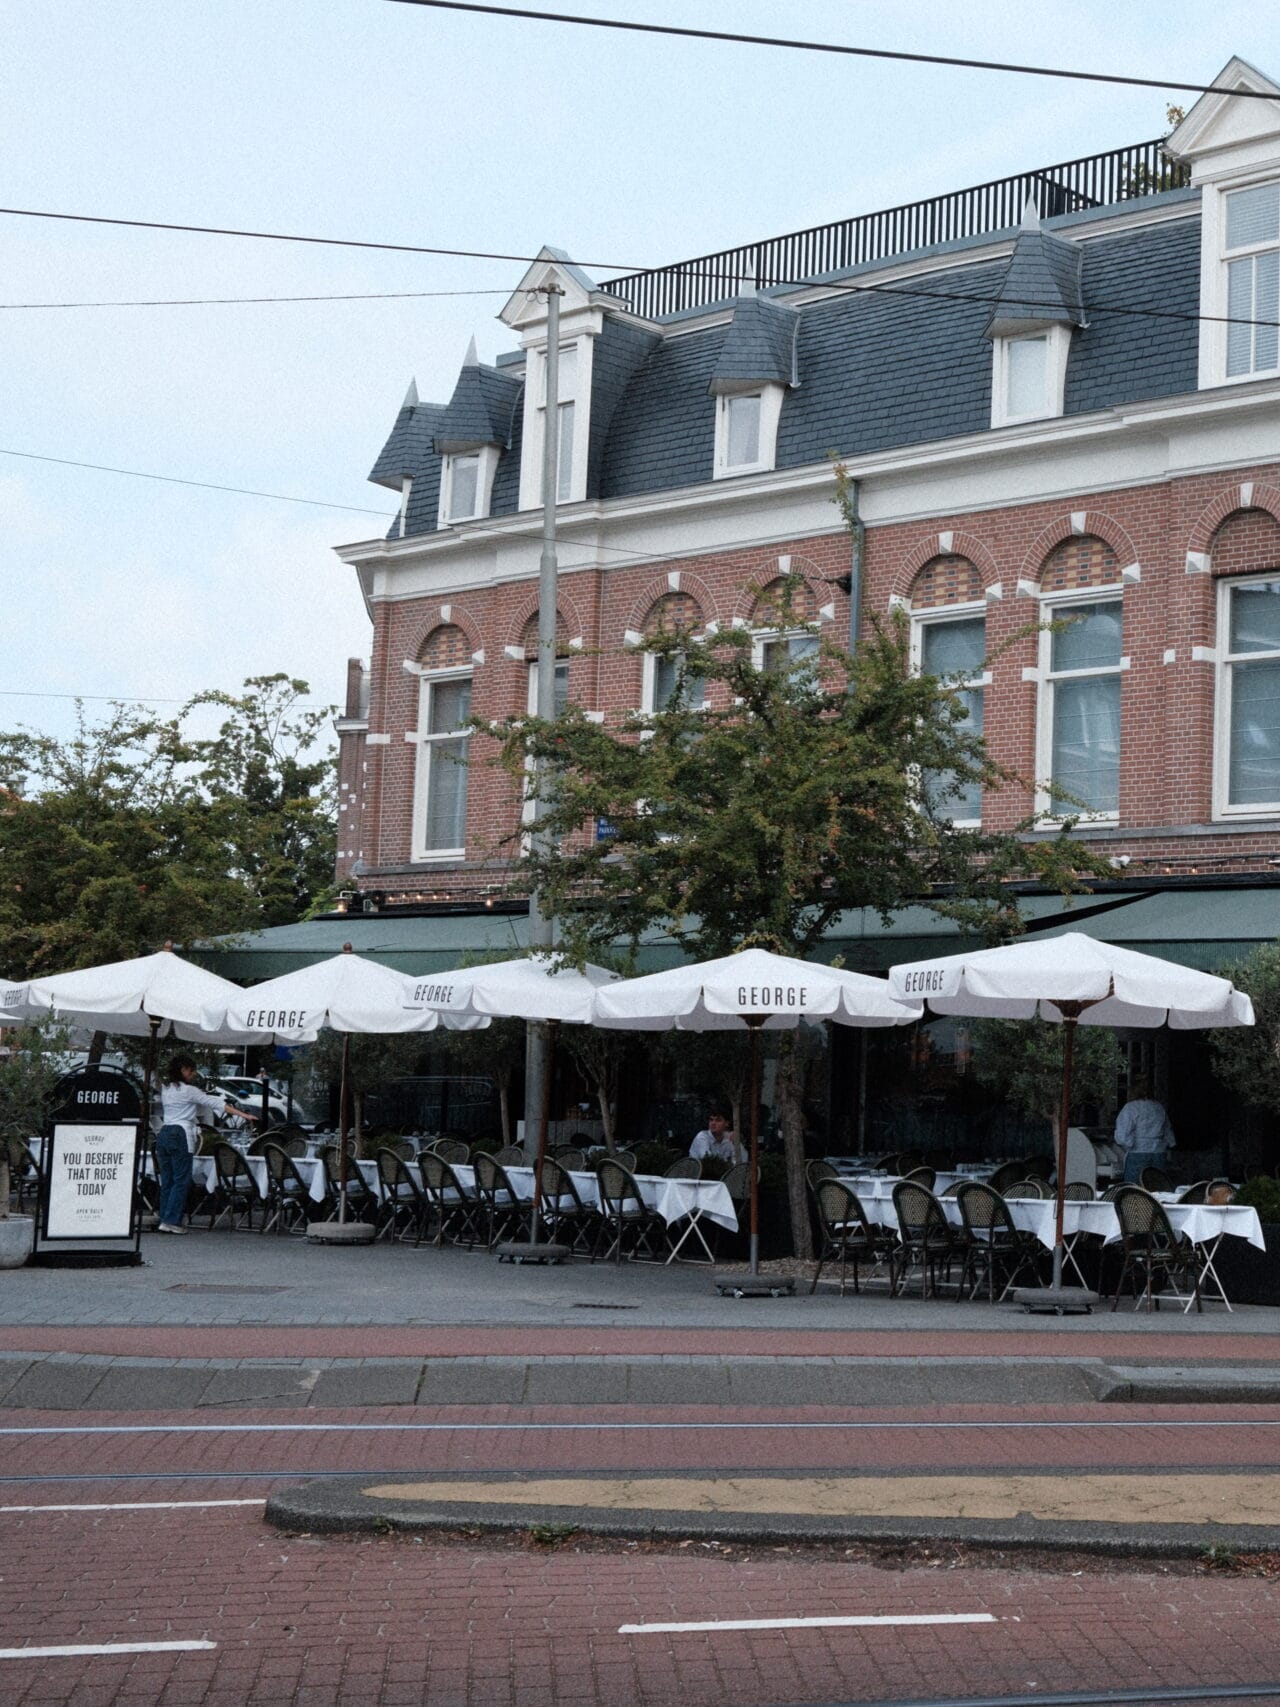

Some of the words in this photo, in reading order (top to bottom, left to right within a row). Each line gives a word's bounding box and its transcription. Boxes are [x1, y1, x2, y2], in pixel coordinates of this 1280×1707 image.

[905, 970, 944, 992] GEORGE
[414, 984, 454, 1003] GEORGE
[738, 987, 807, 1006] GEORGE
[246, 1010, 306, 1028] GEORGE
[77, 1090, 120, 1104] GEORGE
[63, 1153, 81, 1165] YOU
[85, 1153, 124, 1165] DESERVE
[68, 1168, 90, 1180] THAT
[77, 1184, 106, 1196] TODAY
